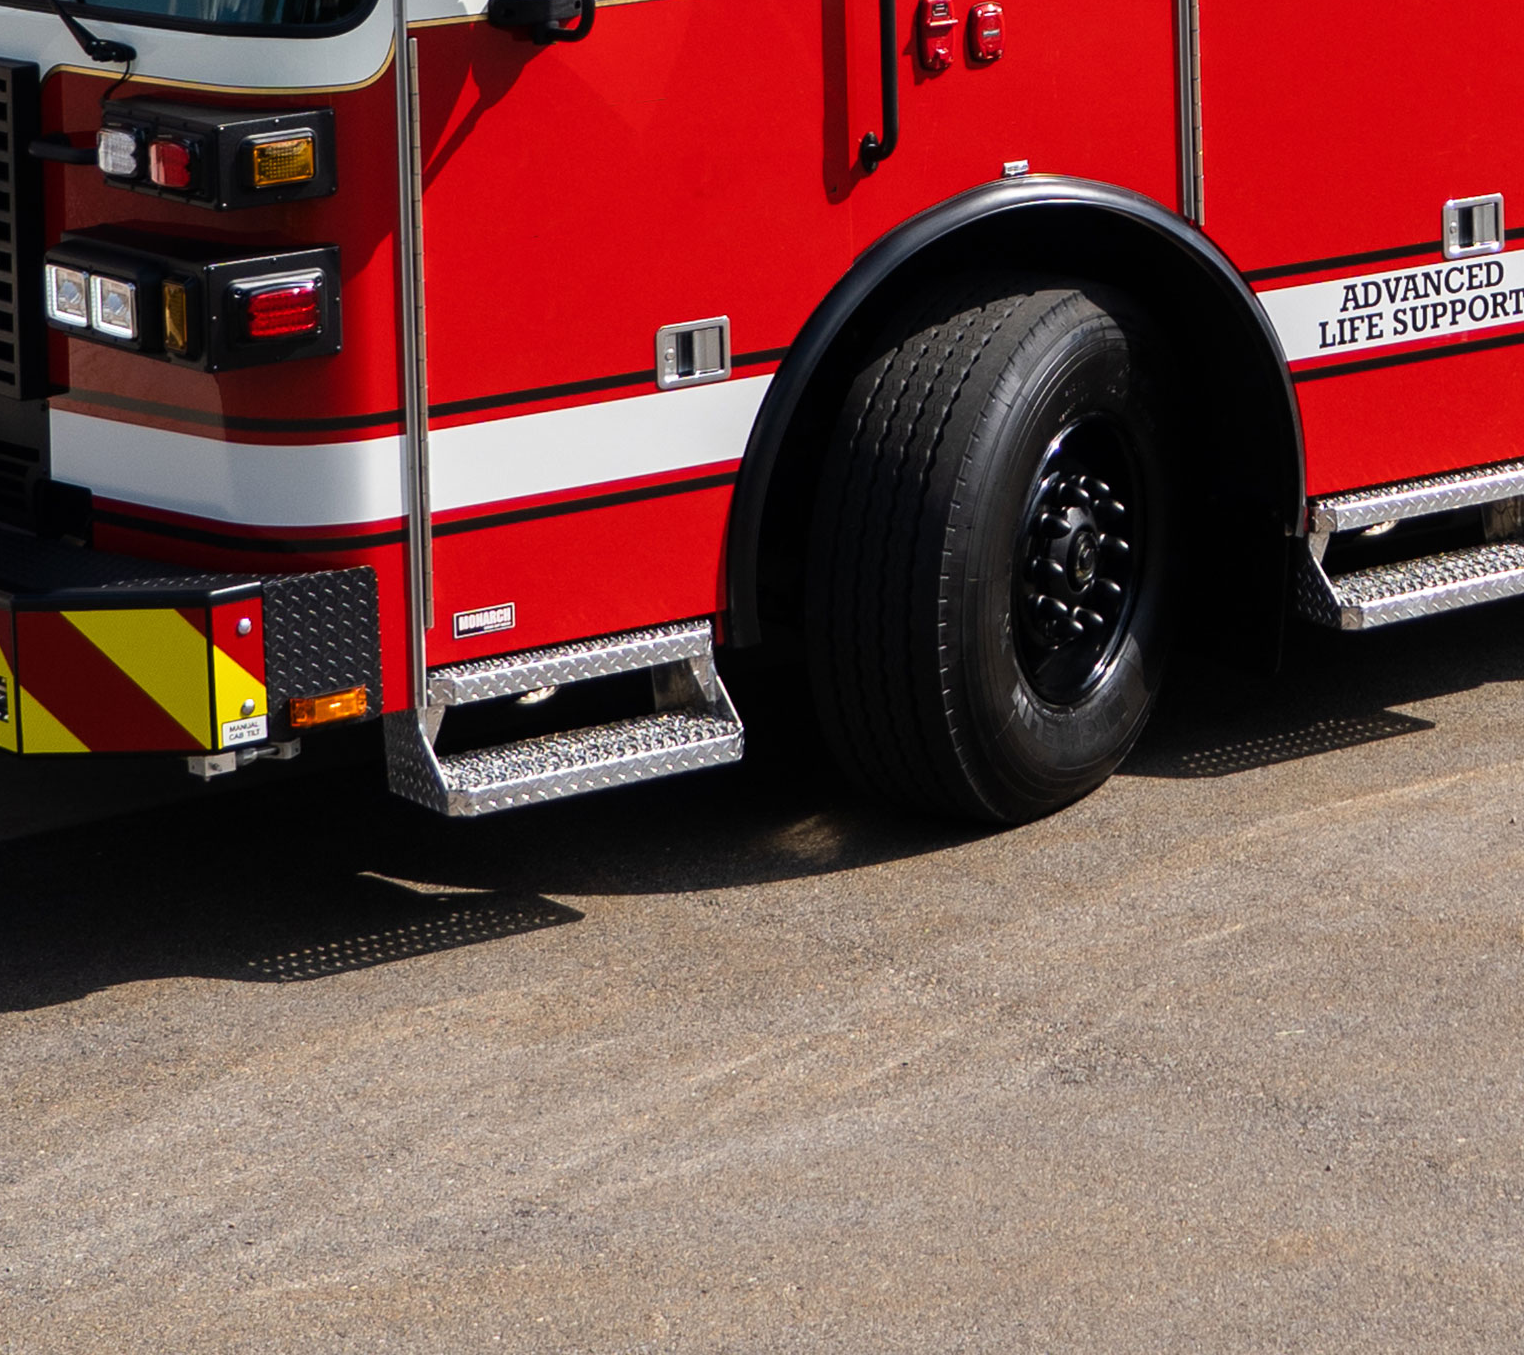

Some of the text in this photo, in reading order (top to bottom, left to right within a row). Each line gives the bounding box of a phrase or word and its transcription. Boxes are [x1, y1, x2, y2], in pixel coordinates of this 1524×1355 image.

[1340, 260, 1505, 312] ADVANCED
[1319, 312, 1384, 349] LIFE
[458, 607, 512, 631] MONARCH
[228, 729, 260, 740] CAB TILT
[229, 722, 258, 732] MANUAL
